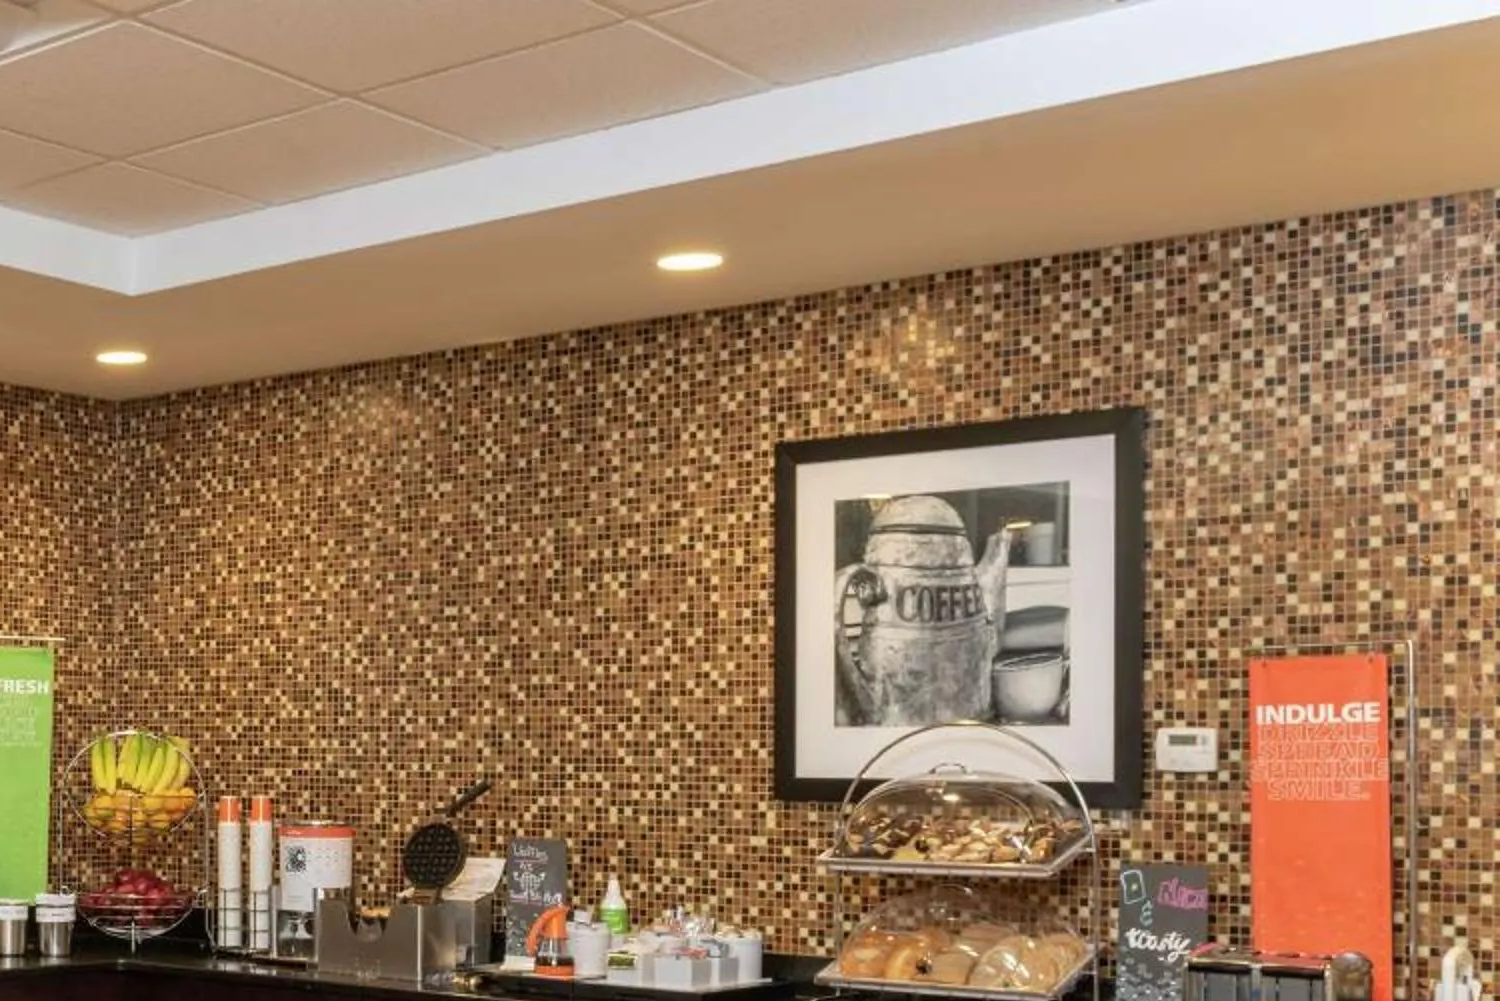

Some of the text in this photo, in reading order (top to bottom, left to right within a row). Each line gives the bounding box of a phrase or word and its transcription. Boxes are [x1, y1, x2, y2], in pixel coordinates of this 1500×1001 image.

[1256, 702, 1381, 725] INDULGE
[1258, 723, 1379, 742] DRIZZLE
[1259, 740, 1380, 761] SPREAD
[1249, 758, 1390, 781] SPRINKLE
[1267, 780, 1371, 801] SMILE.
